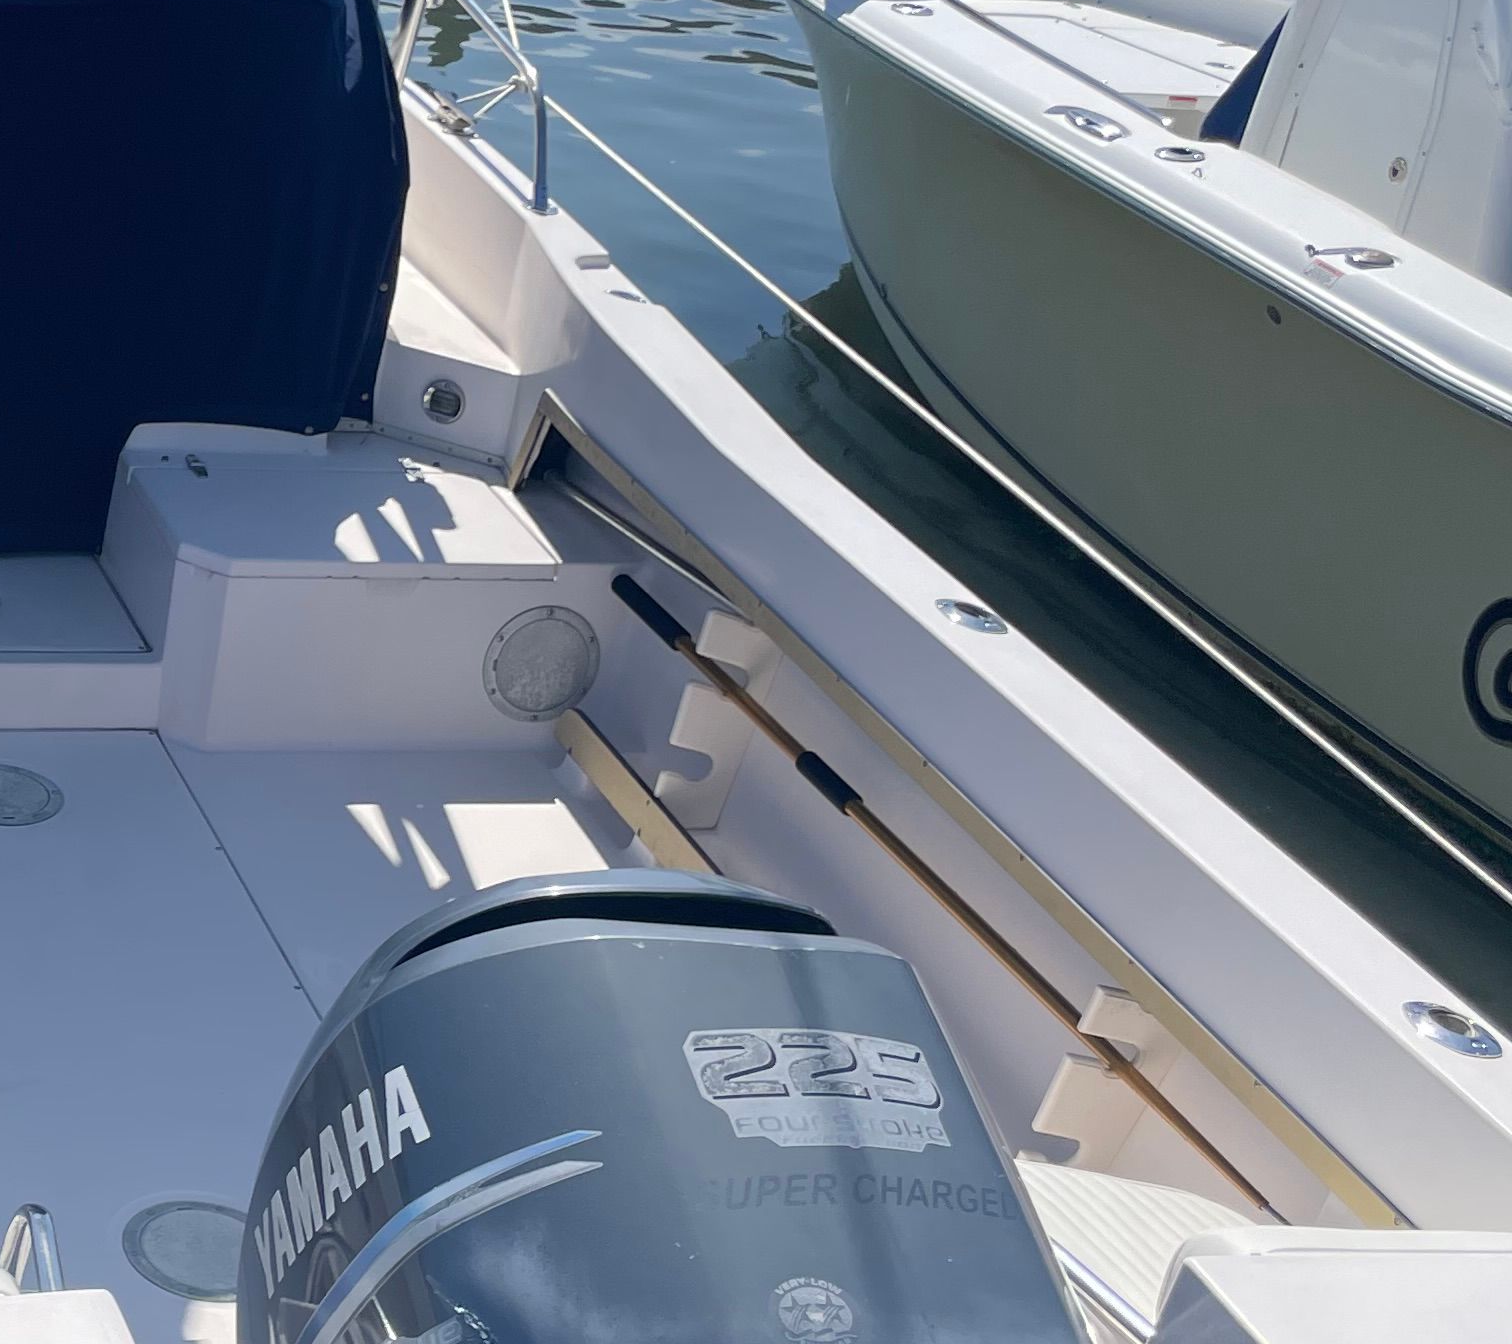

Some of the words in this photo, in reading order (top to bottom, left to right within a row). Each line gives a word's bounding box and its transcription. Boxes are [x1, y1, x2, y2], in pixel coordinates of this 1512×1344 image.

[691, 1031, 943, 1110] 225
[253, 1064, 431, 1299] YAMAHA
[702, 1172, 839, 1211] UPER
